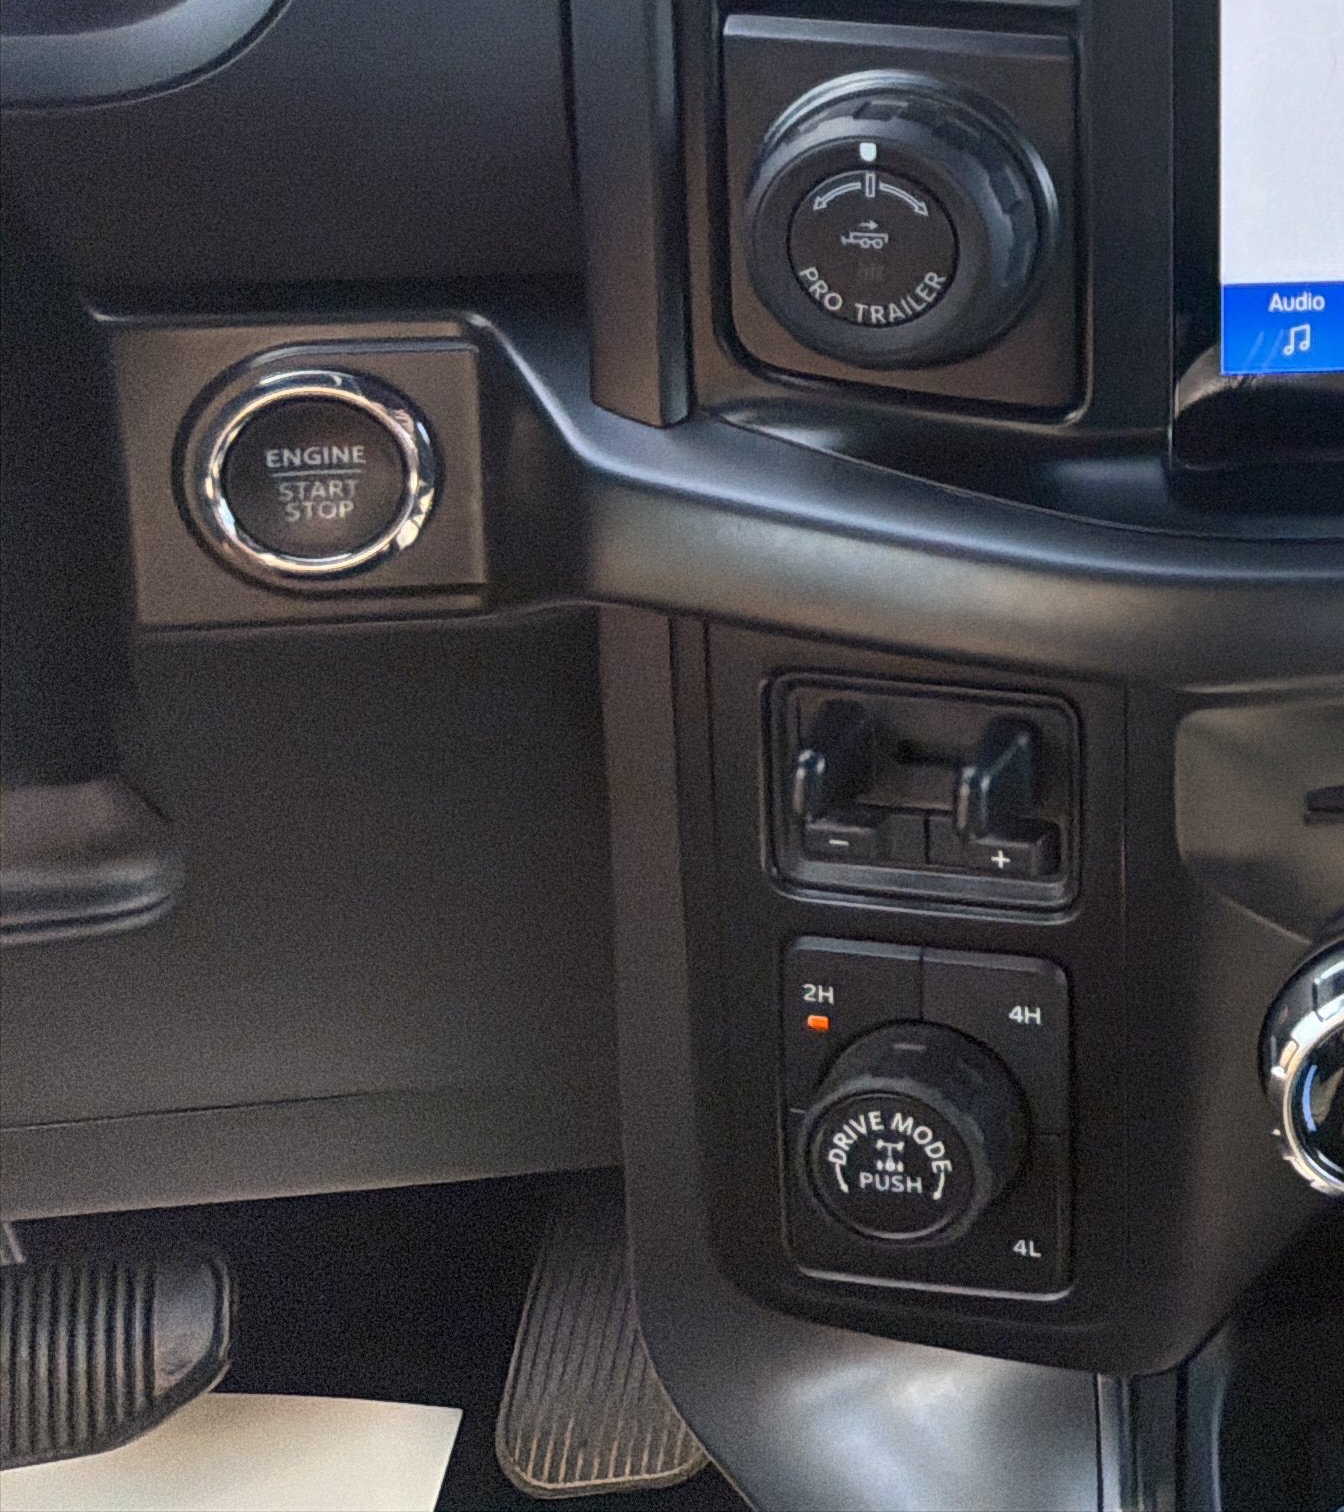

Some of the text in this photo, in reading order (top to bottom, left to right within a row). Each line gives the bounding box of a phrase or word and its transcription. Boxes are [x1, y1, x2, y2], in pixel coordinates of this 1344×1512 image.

[798, 265, 947, 323] PRO TRAILER
[1268, 291, 1325, 313] Audio
[265, 444, 367, 469] ENGINE
[277, 478, 359, 501] START
[284, 500, 355, 522] STOP
[801, 982, 835, 1006] 2H
[1008, 1004, 1042, 1026] 4H
[827, 1110, 952, 1174] DRIVE MODE
[858, 1171, 923, 1195] PUSH
[1012, 1238, 1043, 1259] 4L
